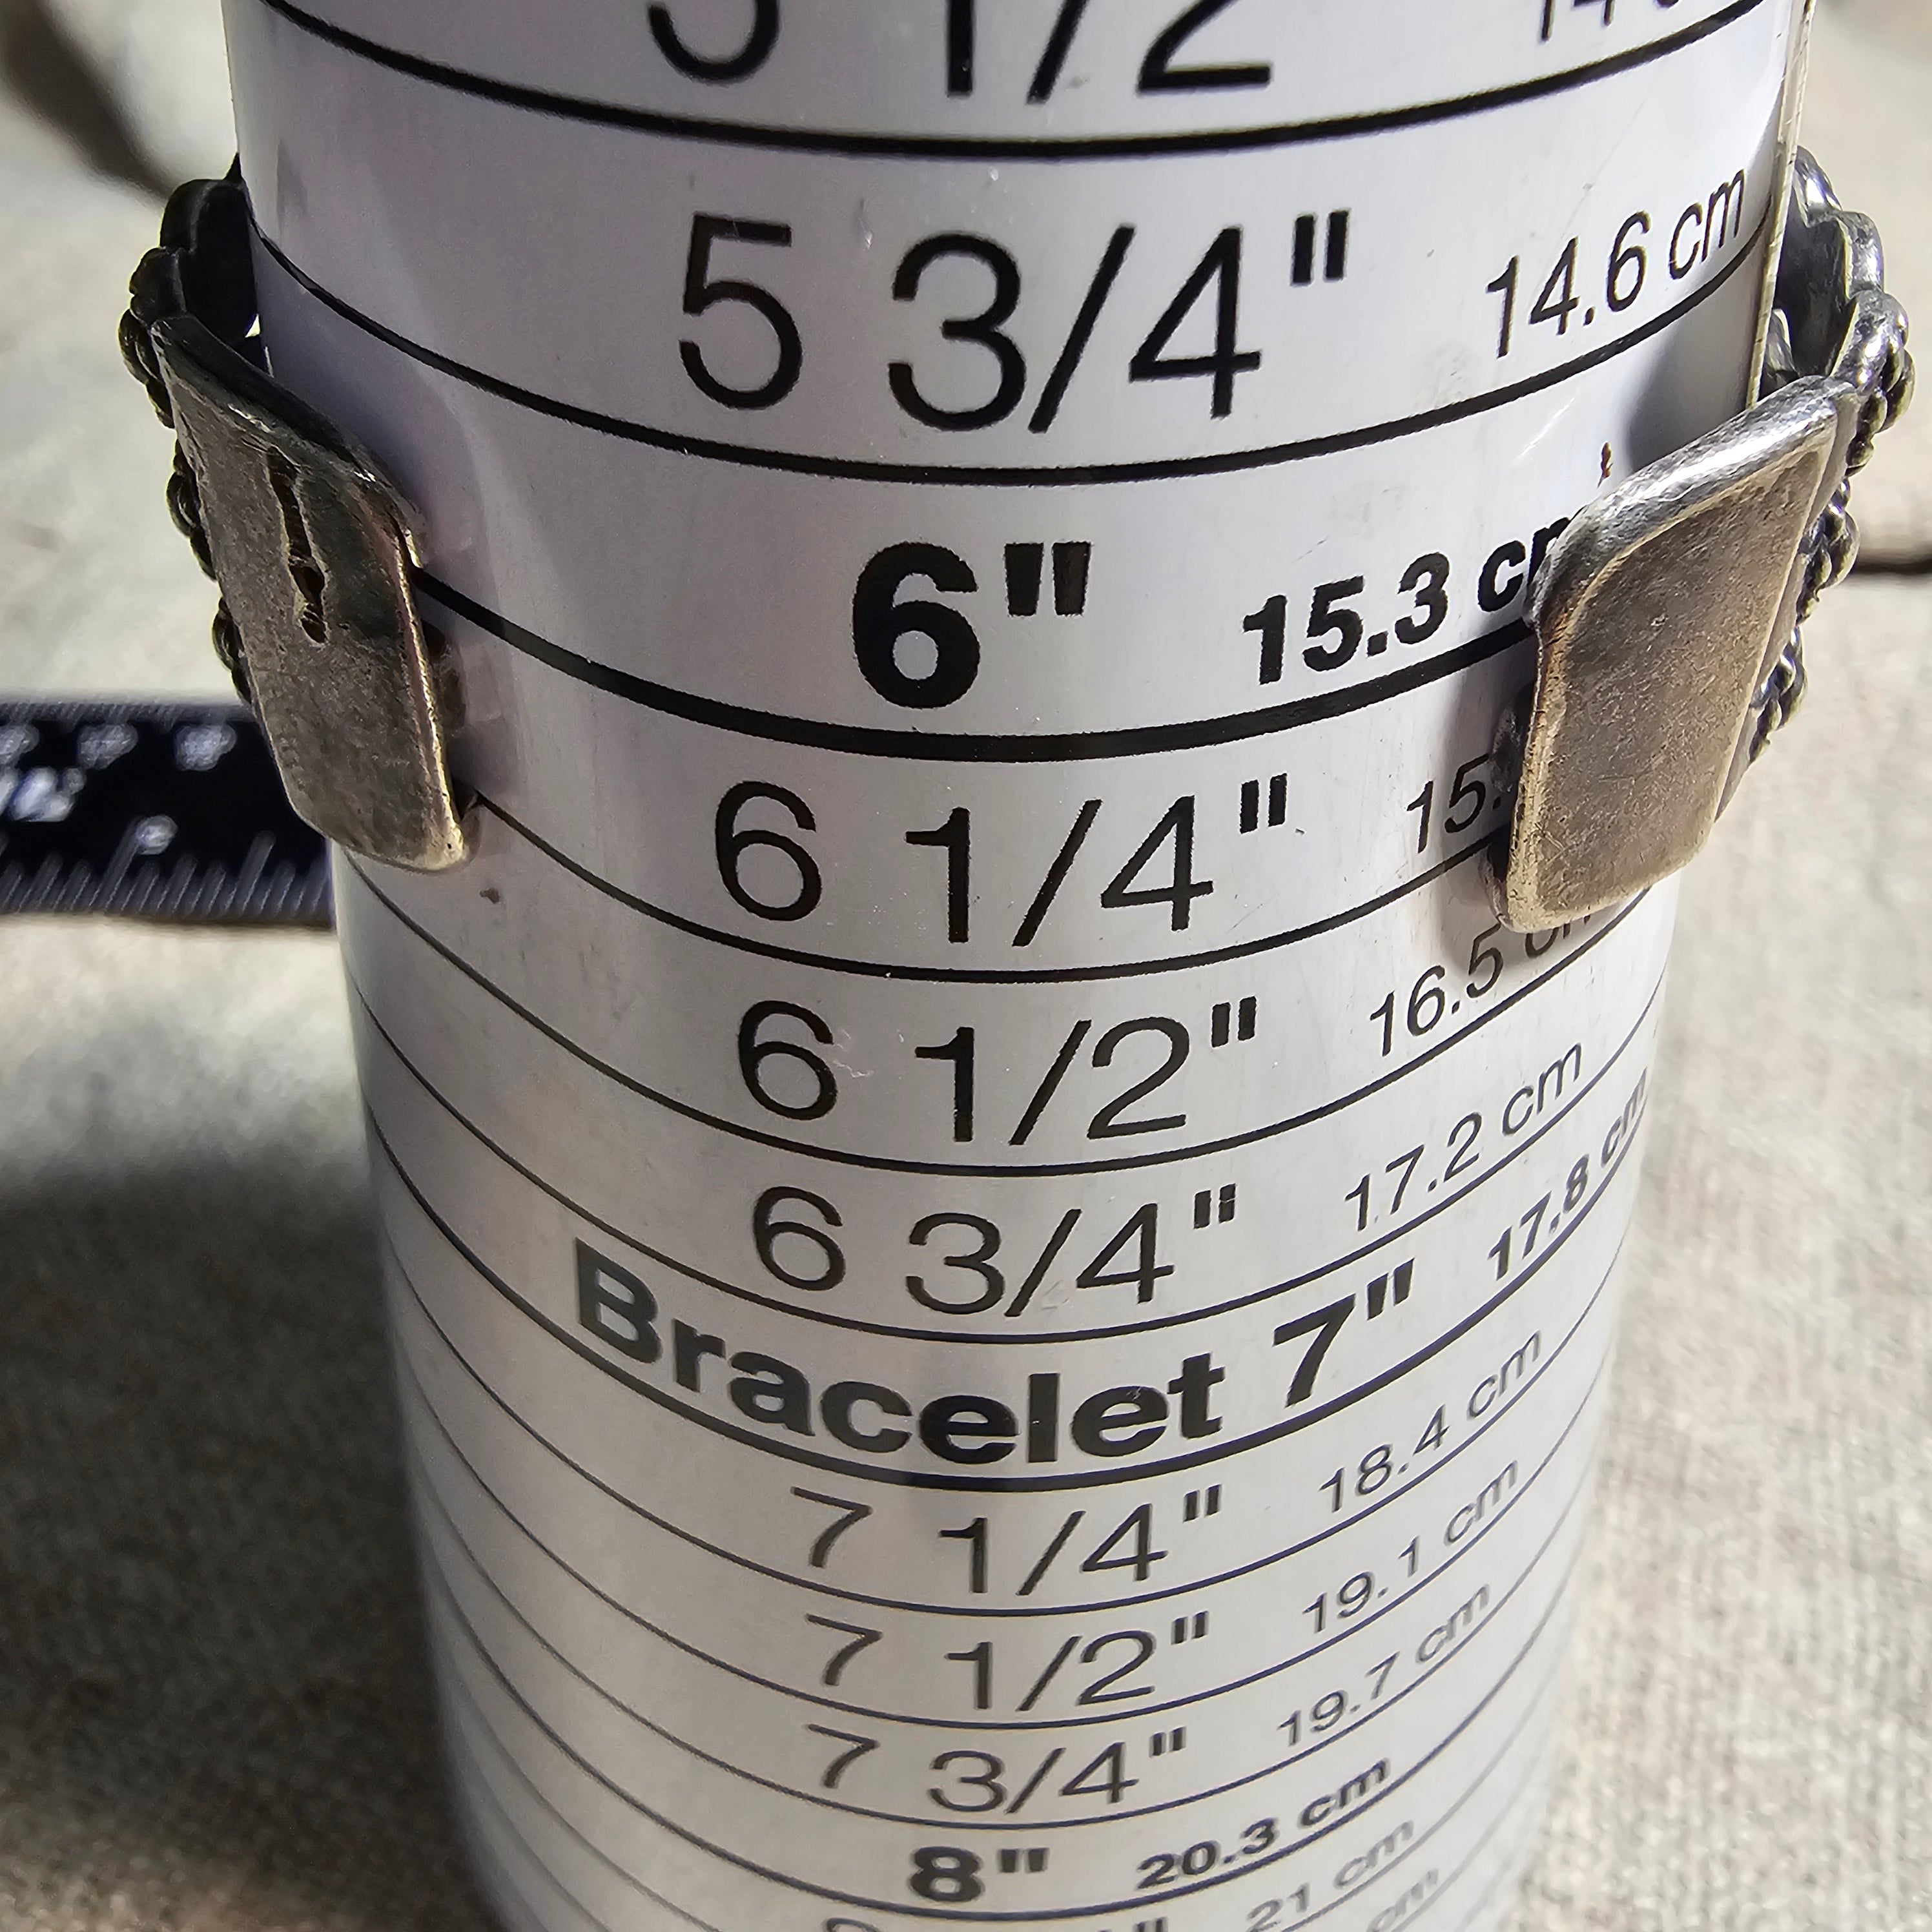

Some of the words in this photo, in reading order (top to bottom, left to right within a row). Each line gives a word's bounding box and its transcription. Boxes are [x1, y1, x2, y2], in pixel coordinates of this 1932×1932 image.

[679, 211, 803, 409] 5
[888, 210, 1350, 433] 3/4"
[1486, 211, 1650, 358] 14.6
[1669, 169, 1744, 280] cm
[852, 541, 1093, 709] 6"
[1242, 551, 1449, 684] 15.3
[715, 781, 822, 921] 6
[904, 773, 1287, 947] 1/4"
[737, 1000, 838, 1120] 6
[914, 996, 1257, 1146] 1/2"
[1370, 923, 1504, 1057] 16.5
[573, 1237, 1225, 1464] Bracelet
[1272, 1258, 1415, 1408] 7"
[1488, 1155, 1589, 1281] 17.8
[1601, 1067, 1647, 1167] cm
[752, 1186, 846, 1291] 6
[905, 1183, 1236, 1317] 3/4"
[1345, 1112, 1482, 1231] 17.2
[1502, 1043, 1581, 1136] cm
[790, 1487, 871, 1568] 7
[938, 1485, 1221, 1596] 1/4"
[1319, 1404, 1450, 1513] 18.4
[1467, 1331, 1540, 1419] cm
[805, 1614, 882, 1686] 7
[944, 1611, 1209, 1711] 1/2"
[1302, 1536, 1419, 1633] 19.1
[1444, 1460, 1517, 1545] cm
[807, 1724, 879, 1789] 7
[927, 1727, 1186, 1814] 3/4"
[1277, 1652, 1400, 1746] 19.7
[1415, 1585, 1488, 1663] cm
[909, 1847, 1049, 1902] 8"
[1137, 1818, 1278, 1889] 20.3
[1299, 1758, 1388, 1827] cm
[1247, 1884, 1310, 1932] 21
[1335, 1822, 1413, 1889] cm
